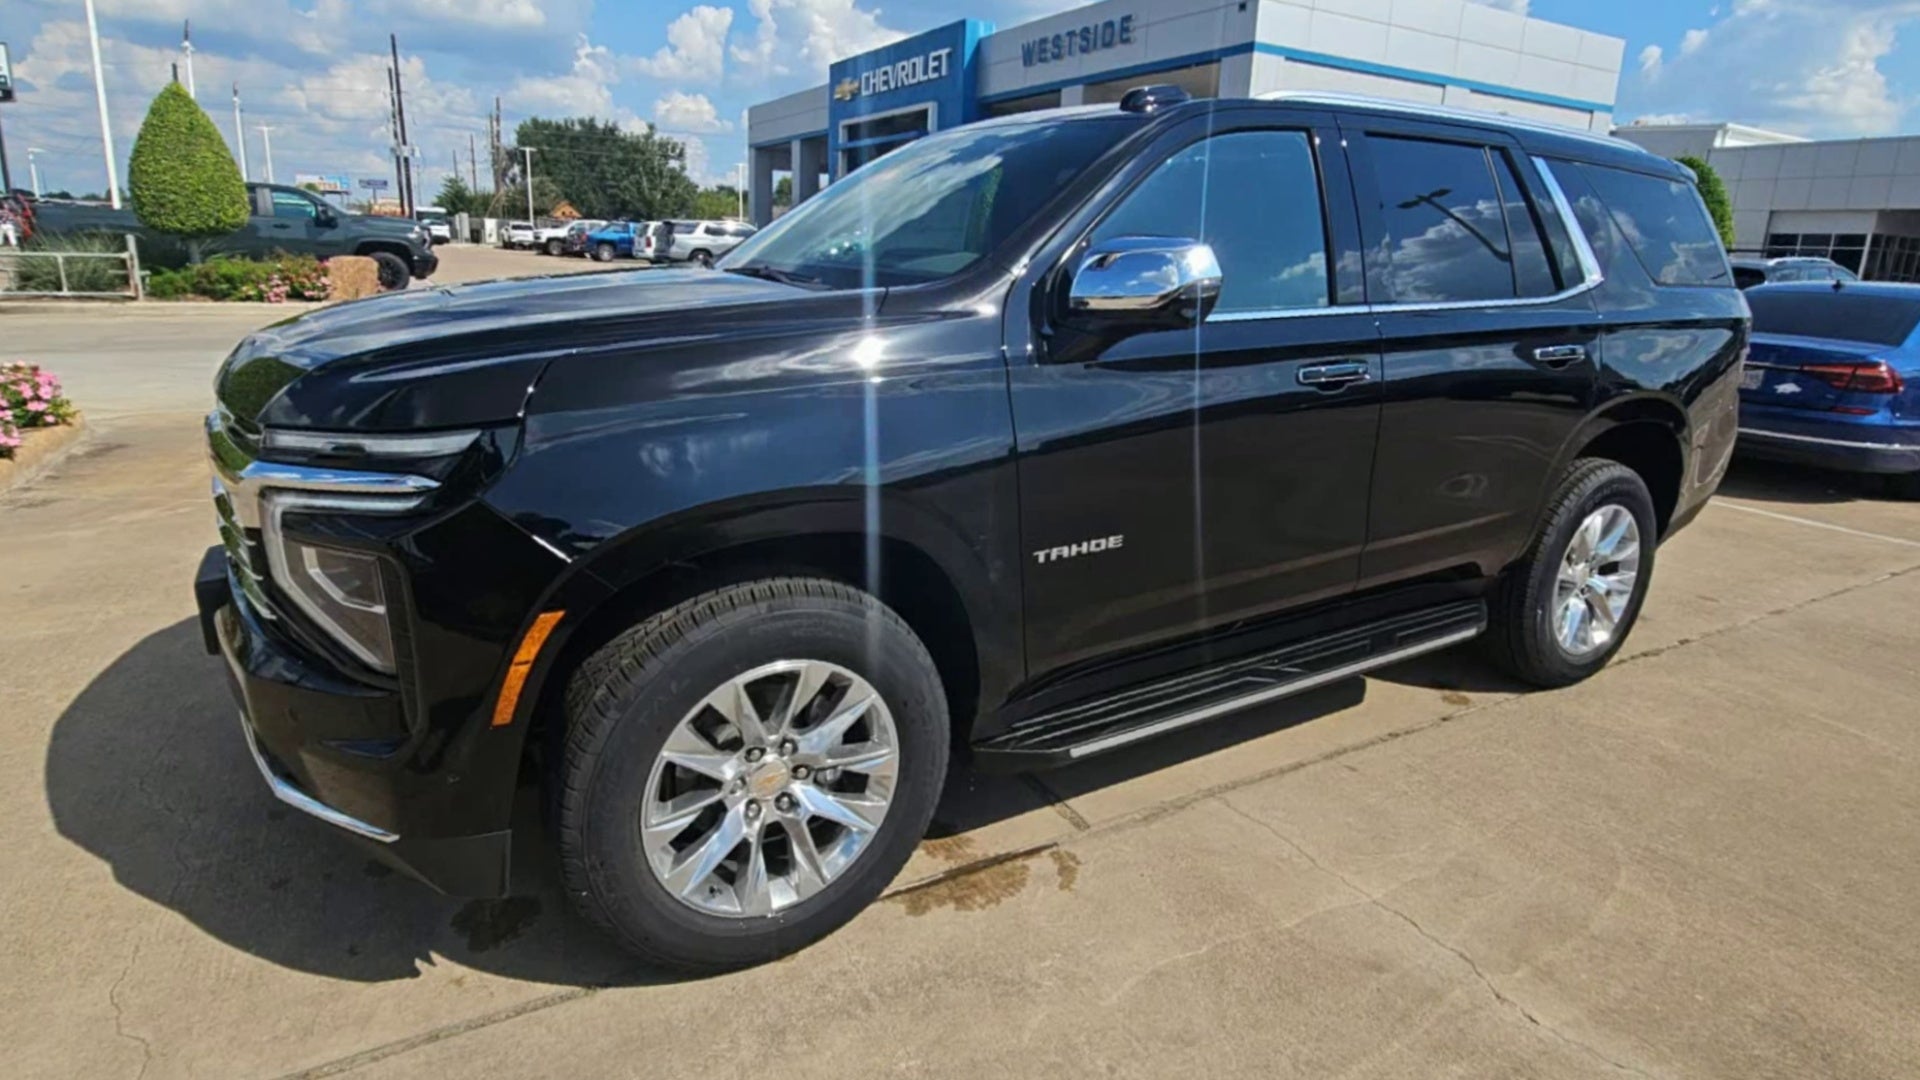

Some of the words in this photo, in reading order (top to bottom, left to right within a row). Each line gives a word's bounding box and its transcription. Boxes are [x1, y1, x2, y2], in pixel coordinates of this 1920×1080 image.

[1021, 14, 1133, 68] WESTSIDE
[861, 48, 951, 96] CHEVROLET
[1033, 534, 1124, 564] TAHOE
